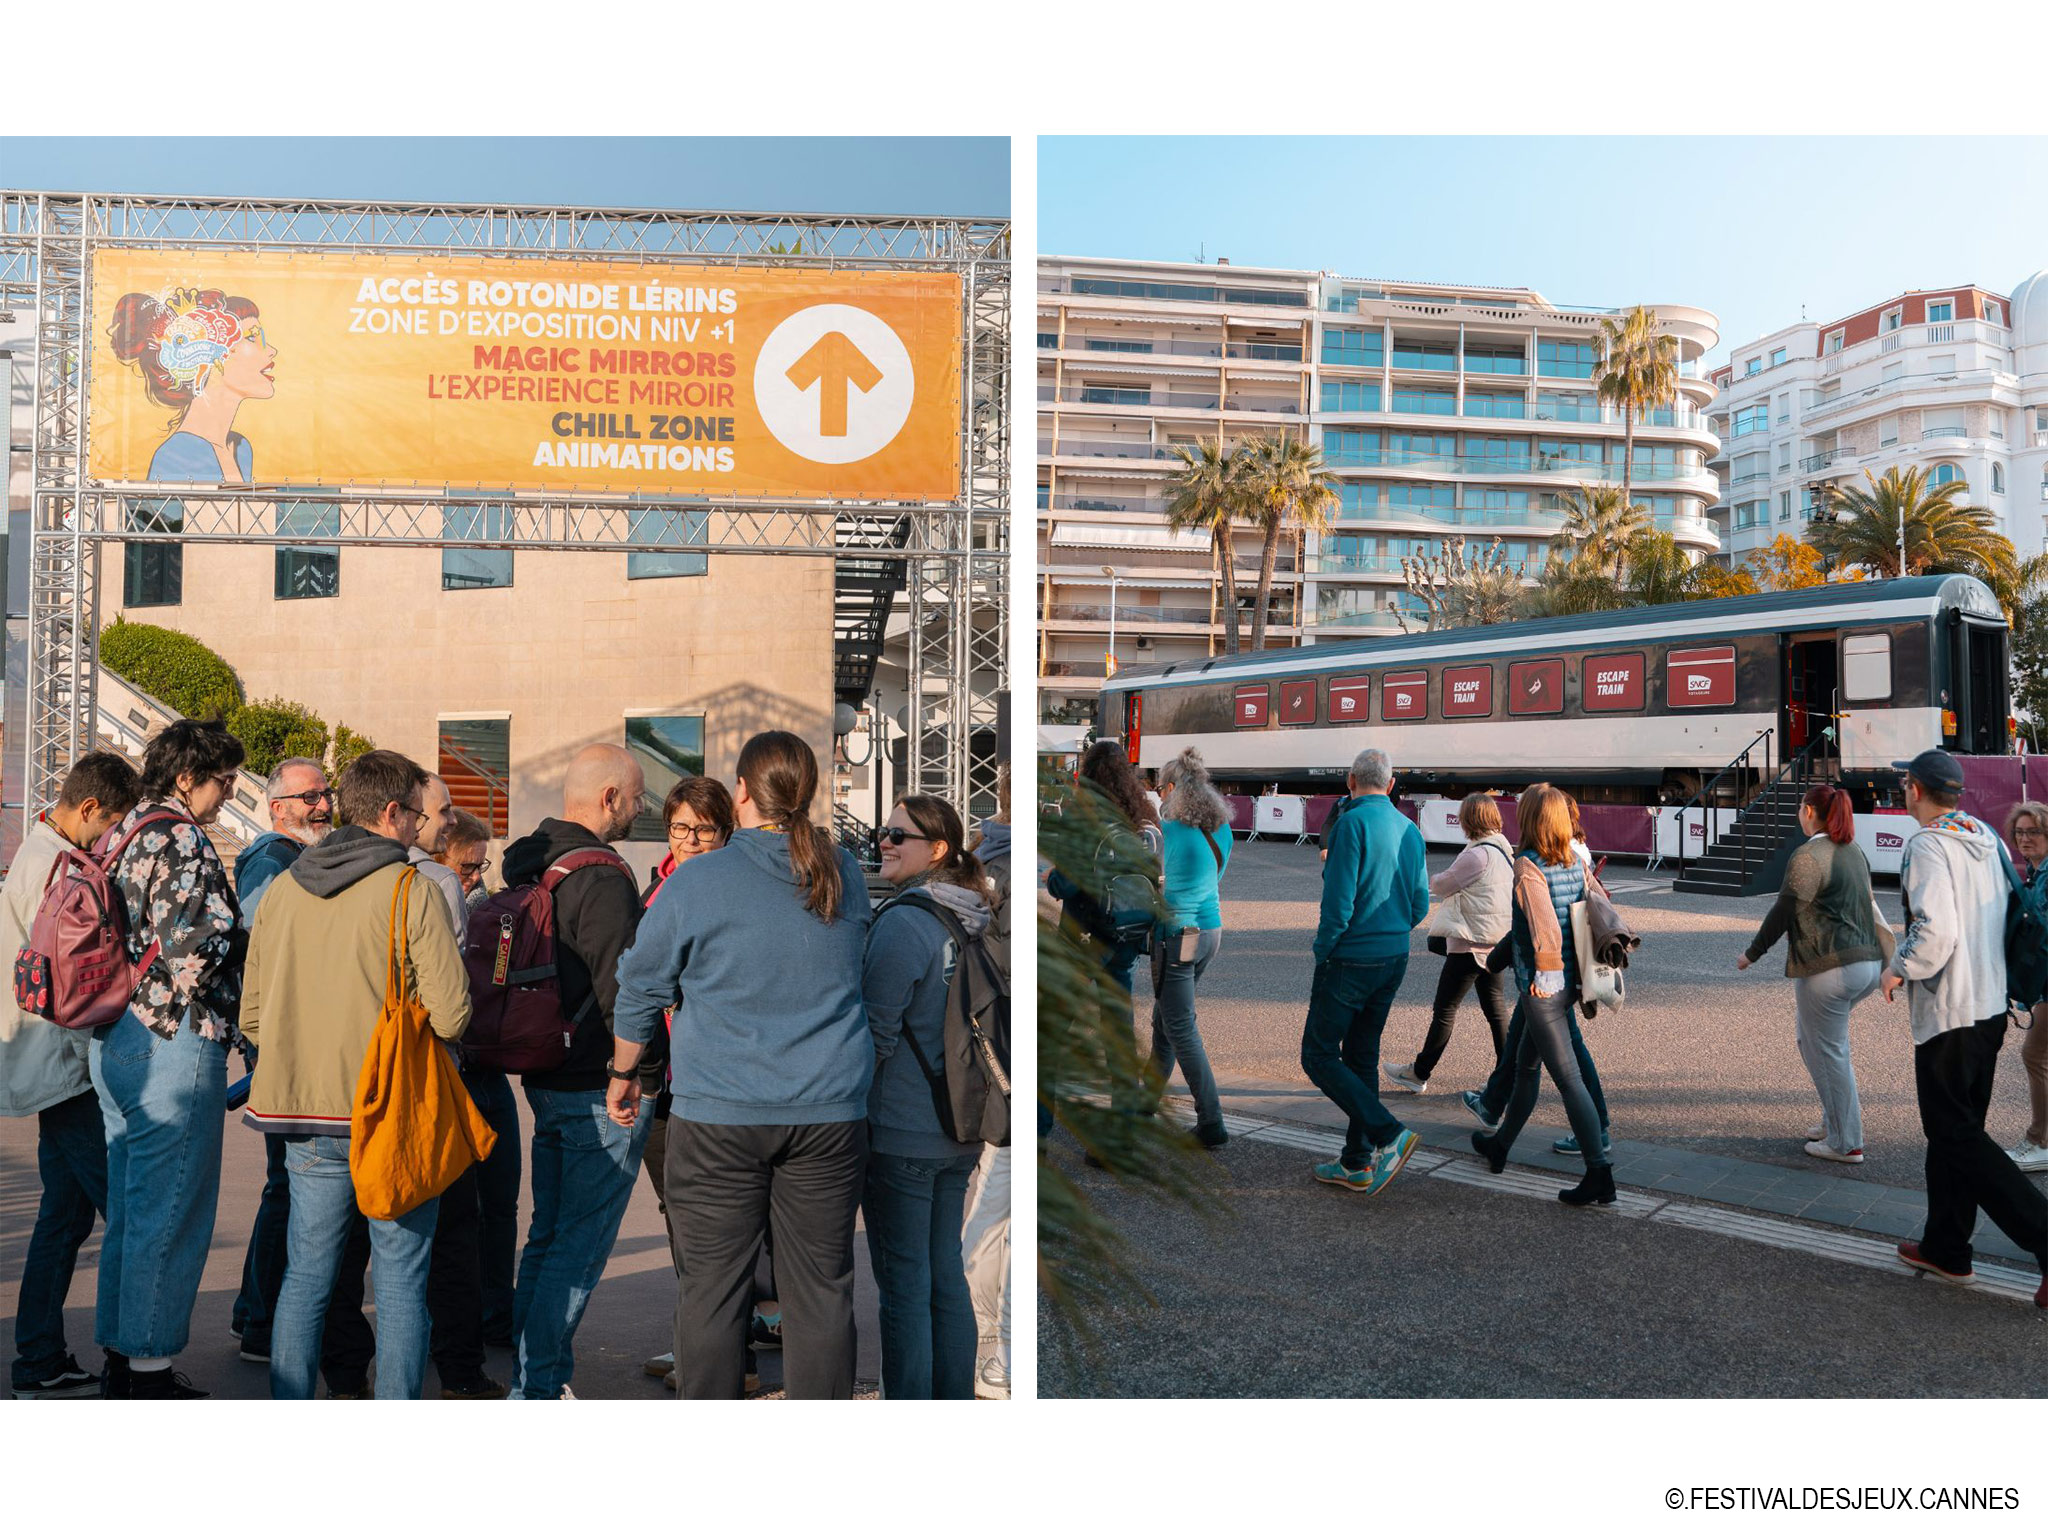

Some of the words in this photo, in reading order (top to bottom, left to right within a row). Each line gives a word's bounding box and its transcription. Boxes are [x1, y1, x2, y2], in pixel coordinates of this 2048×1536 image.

[356, 272, 459, 304] ACCÈS
[468, 281, 619, 311] ROTONDE
[629, 279, 737, 314] LÉRINS
[348, 308, 429, 335] ZONE
[439, 310, 641, 341] D'EXPOSITION
[651, 316, 701, 343] NIV
[711, 319, 735, 344] +1
[474, 345, 580, 372] MAGIC
[590, 348, 736, 378] MIRRORS
[428, 369, 619, 404] L'EXPÉRIENCE
[630, 380, 735, 408] MIROIR
[552, 411, 641, 439] CHILL
[650, 415, 735, 442] ZONE
[533, 441, 735, 472] ANIMATIONS
[1453, 681, 1480, 692] ESCAPE
[1597, 670, 1629, 683] ESCAPE
[1597, 683, 1625, 696] TRAIN
[1453, 692, 1476, 704] TRAIN
[496, 943, 508, 978] CANNES
